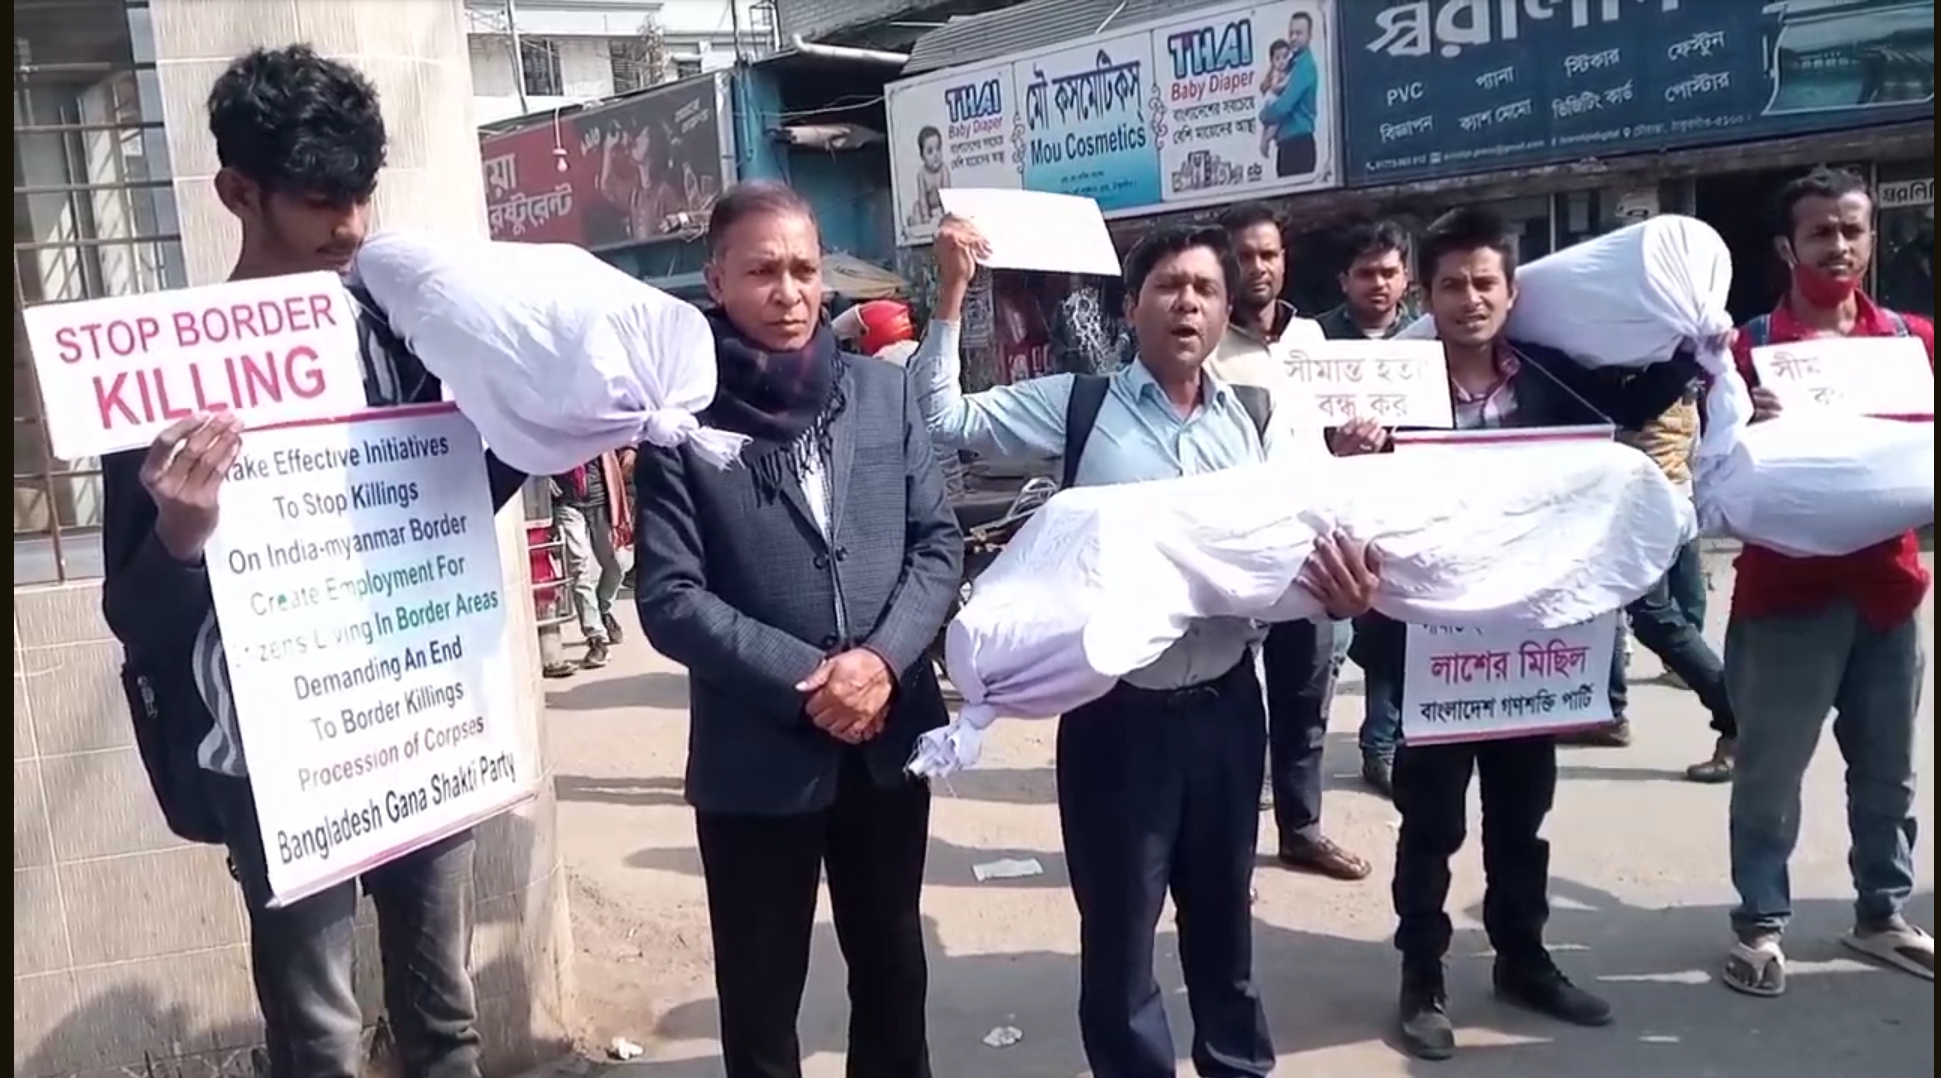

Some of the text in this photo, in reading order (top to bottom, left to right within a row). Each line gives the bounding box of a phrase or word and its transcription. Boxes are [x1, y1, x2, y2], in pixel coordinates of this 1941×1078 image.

[1168, 18, 1254, 80] THAI
[1564, 48, 1620, 78] স্টিকার
[1667, 30, 1726, 61] ফেস্টুন
[944, 78, 1002, 123] THAI
[1171, 69, 1255, 101] Baby Diaper
[1386, 81, 1424, 107] PVC
[1664, 71, 1731, 102] পোস্টার
[948, 122, 971, 140] Baby
[1030, 138, 1062, 166] Mou
[1064, 122, 1146, 160] Cosmetics
[488, 182, 573, 236] রষ্টুরেন্ট
[55, 294, 336, 364] STOP BORDER
[92, 346, 326, 430] KILLING
[1283, 349, 1366, 382] সীমান্ত
[1367, 393, 1408, 417] কর
[273, 446, 360, 477] Effective
[363, 435, 450, 465] Initiatives
[273, 481, 419, 521] To Stop Killings
[228, 514, 468, 574] On India-myanmar Border
[325, 564, 436, 600] Employment
[436, 554, 466, 578] For
[314, 618, 374, 650] Lving
[375, 611, 394, 637] In
[397, 600, 451, 632] Border
[455, 590, 499, 619] Areas
[293, 634, 464, 700] Demanding An End
[1430, 639, 1592, 684] লাশের মিছিল
[311, 681, 465, 742] To Border Killings
[1419, 682, 1596, 724] বাংলাদেশ গণশক্তি পার্টি
[298, 715, 485, 792] Procession of Corpses
[277, 750, 517, 865] Bangladesh Gana Shakti Party
